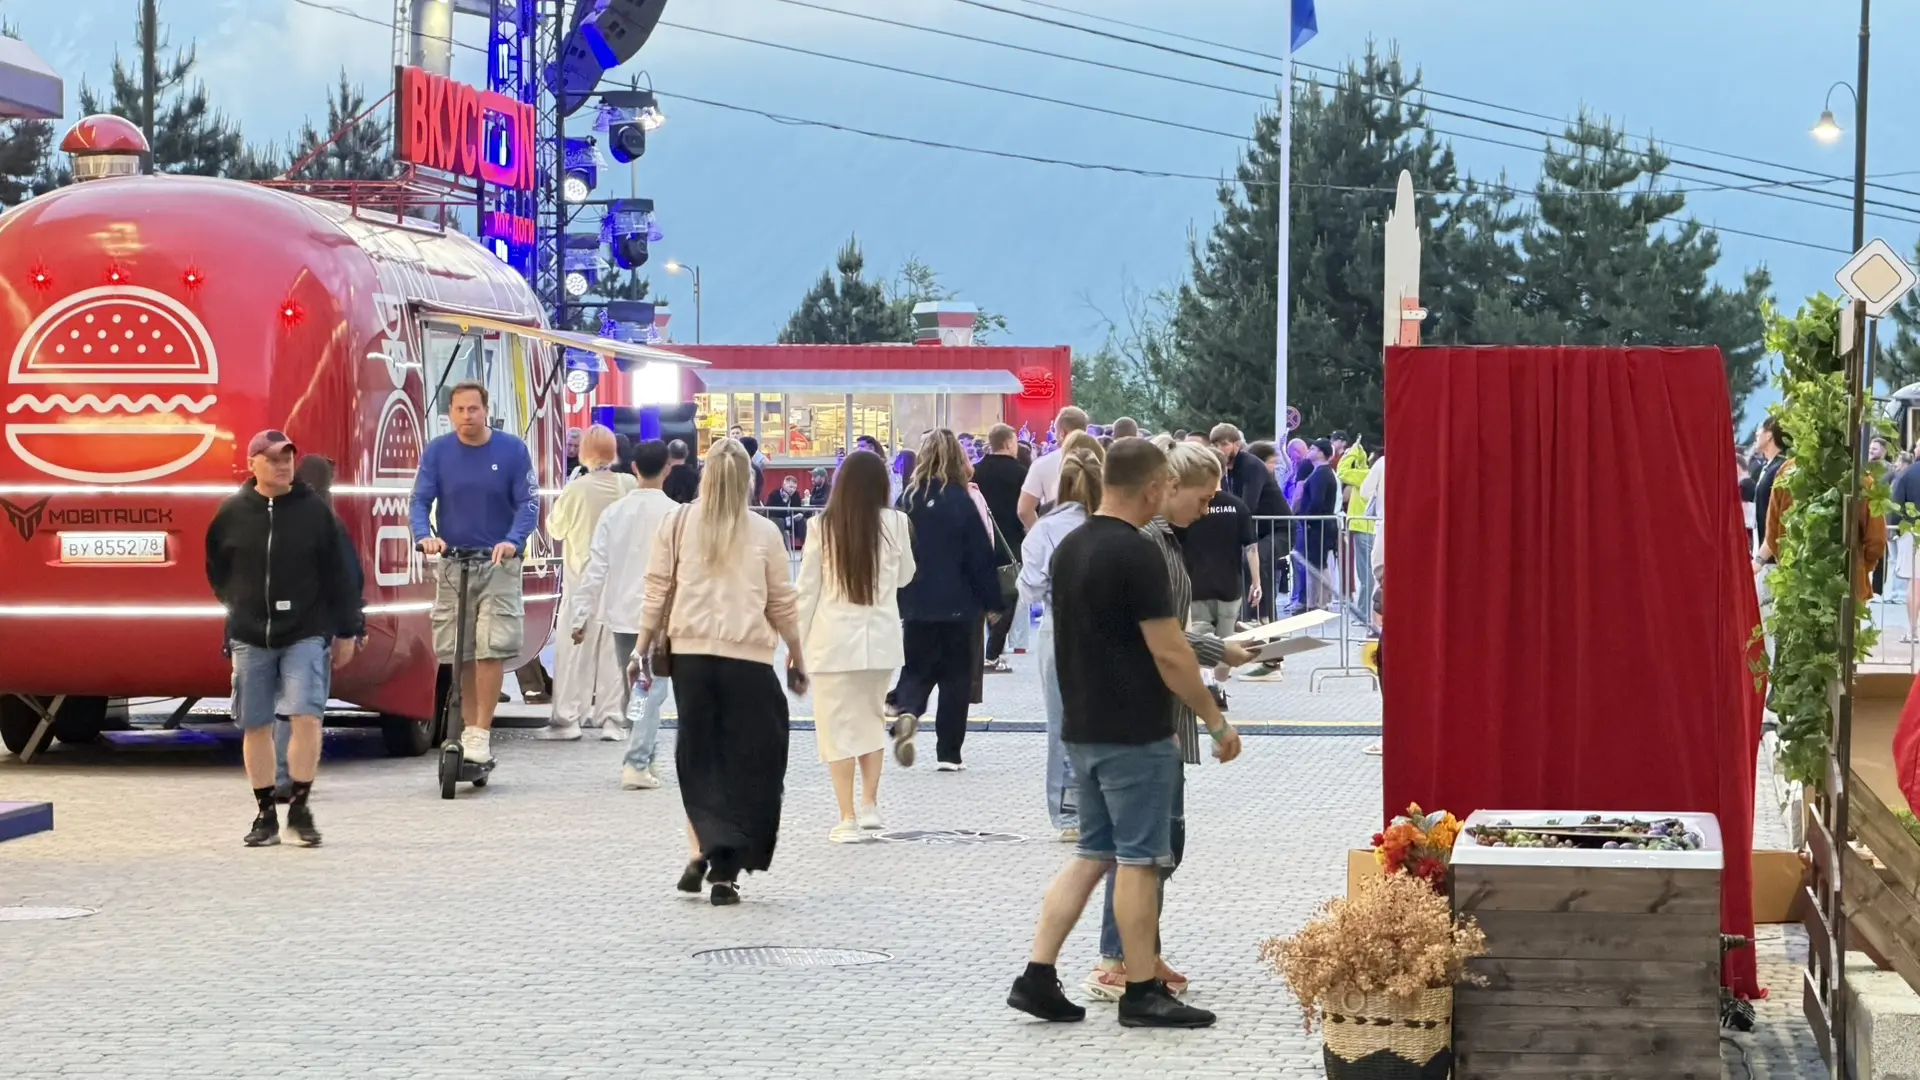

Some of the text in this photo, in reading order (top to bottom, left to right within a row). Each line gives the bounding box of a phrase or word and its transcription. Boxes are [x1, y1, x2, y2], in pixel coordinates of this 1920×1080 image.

[48, 508, 173, 524] MOBITRUCK
[94, 539, 137, 556] 8552
[140, 538, 159, 552] 78
